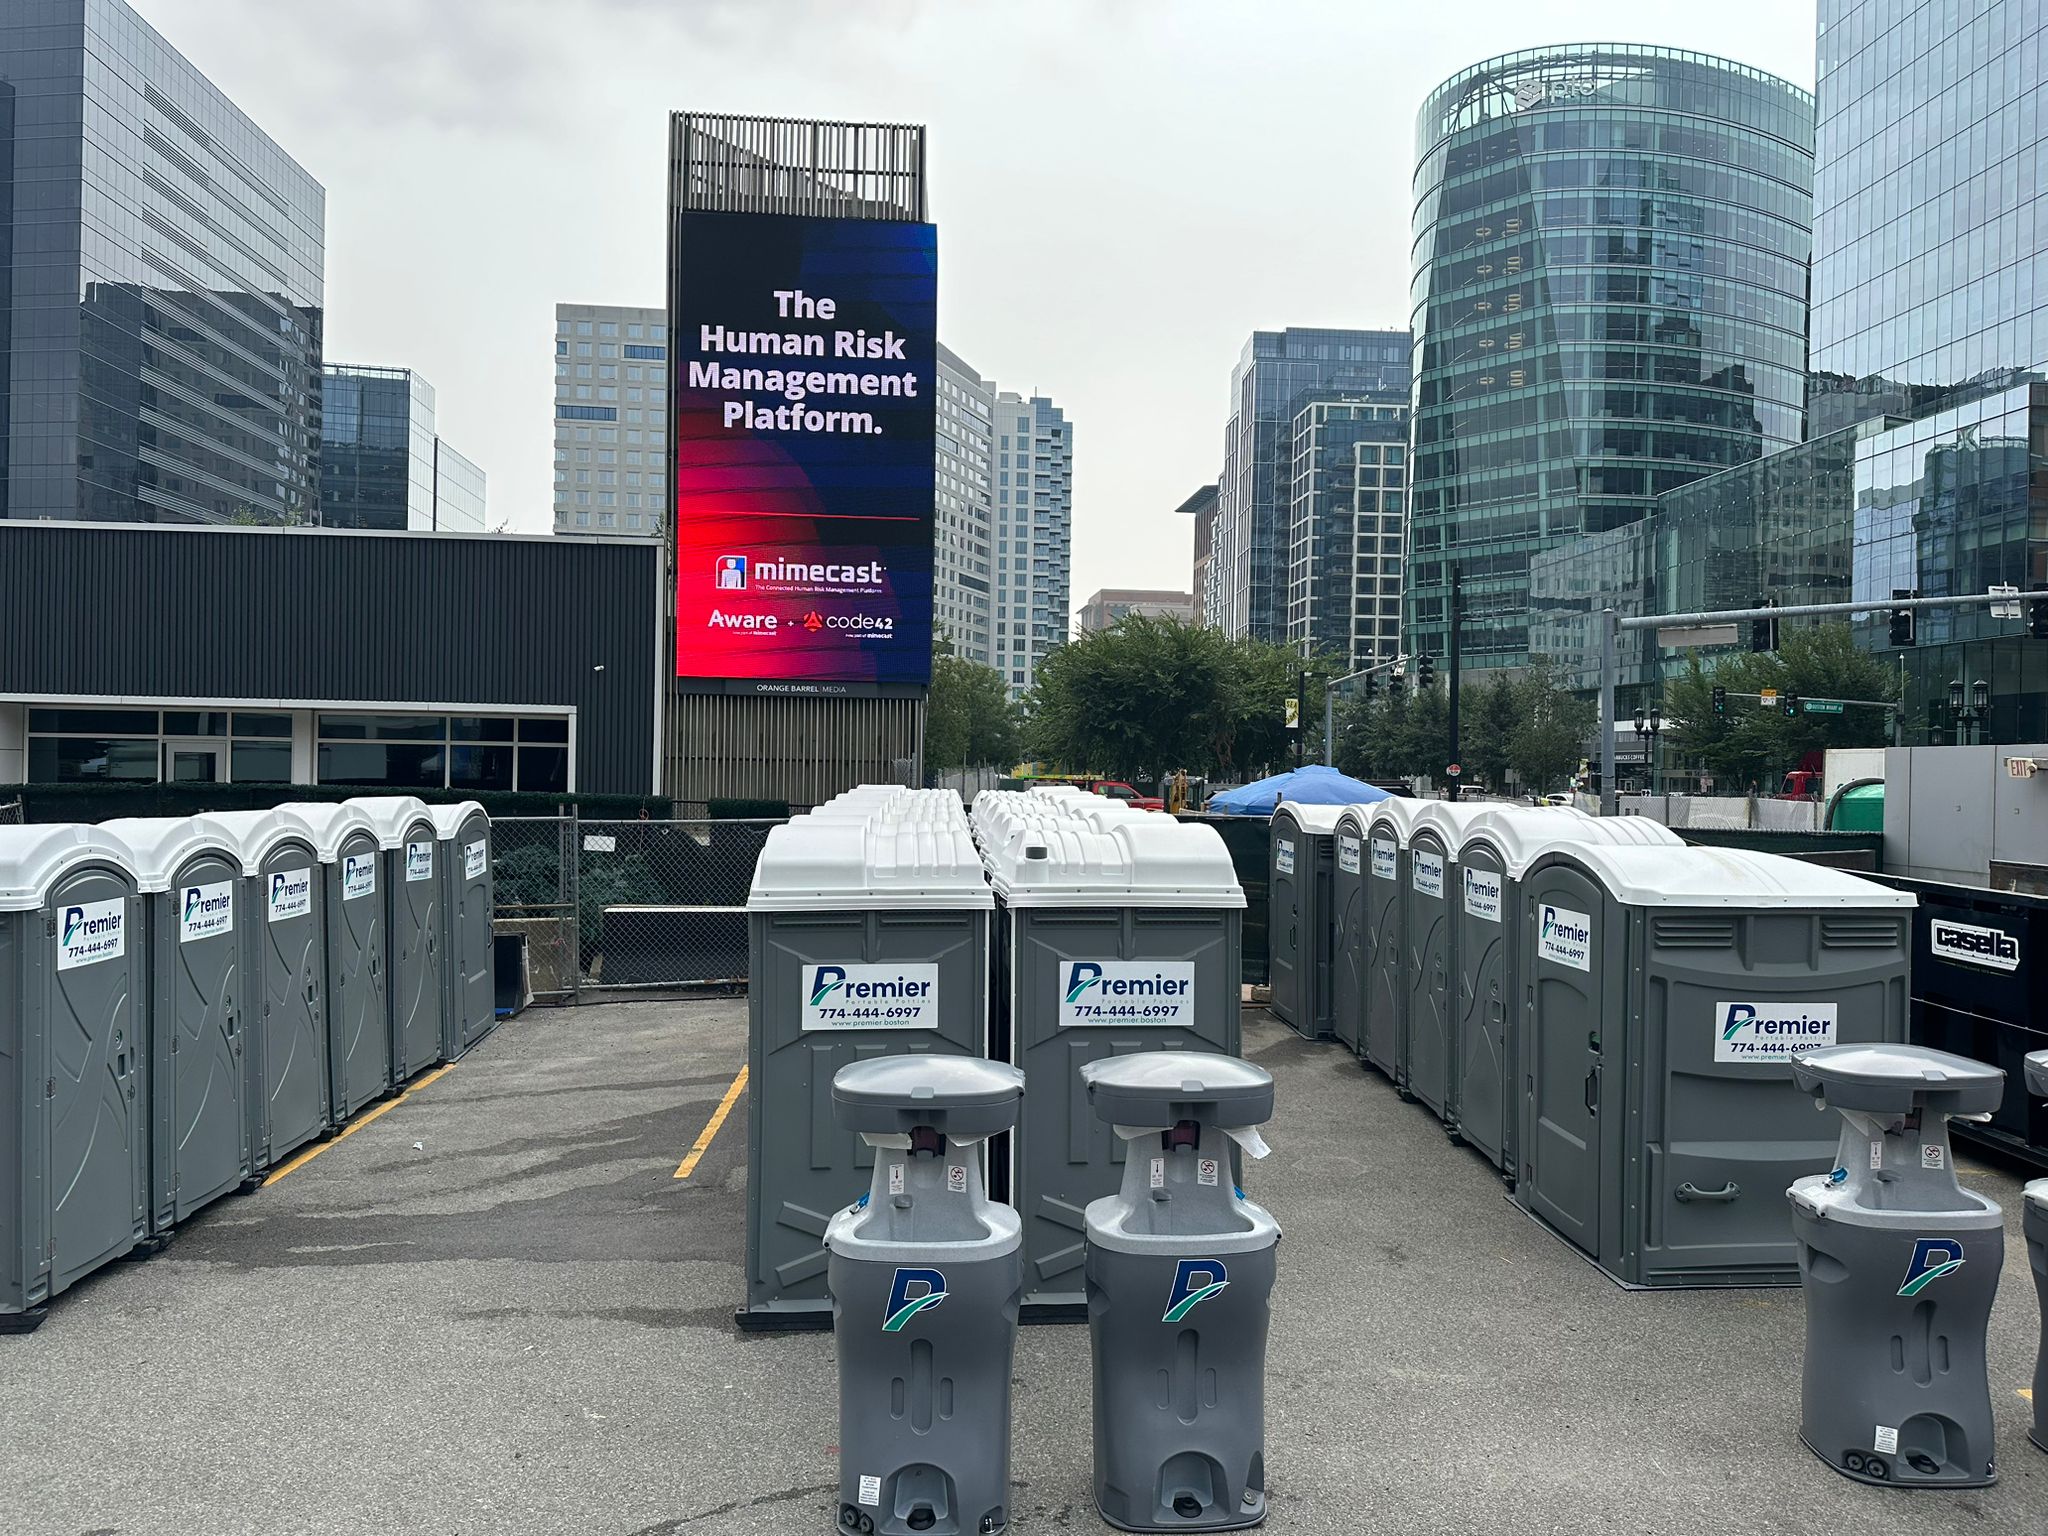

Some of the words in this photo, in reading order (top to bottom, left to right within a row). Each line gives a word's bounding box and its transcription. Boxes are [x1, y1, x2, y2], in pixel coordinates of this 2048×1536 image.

[773, 290, 836, 320] The
[701, 325, 825, 356] Human
[834, 329, 906, 360] Risk
[689, 361, 918, 400] Management
[723, 401, 883, 435] Platform.
[755, 557, 884, 584] mimecast
[825, 586, 859, 594] Management
[707, 609, 778, 629] Aware
[826, 613, 893, 631] code42
[757, 684, 789, 692] ORANGE
[790, 685, 819, 693] BARREL
[2010, 759, 2027, 777] EXIT
[345, 857, 373, 885] Premier
[1414, 850, 1441, 878] Premier
[271, 873, 308, 904] Premier
[1466, 868, 1499, 898] Premier
[184, 887, 230, 922] Premier
[62, 906, 122, 947] Premier
[1542, 906, 1588, 943] Premier
[68, 938, 118, 958] 774-444-6997
[1545, 941, 1585, 960] 774-444-6997
[1936, 926, 2016, 961] casella
[809, 966, 931, 1006] Premier
[1065, 962, 1189, 1003] Premier
[819, 1007, 921, 1019] 774-444-6997
[1074, 1005, 1179, 1017] 774-444-6997
[1088, 1017, 1167, 1025] www.premier.boston
[1722, 1004, 1831, 1041] Premier
